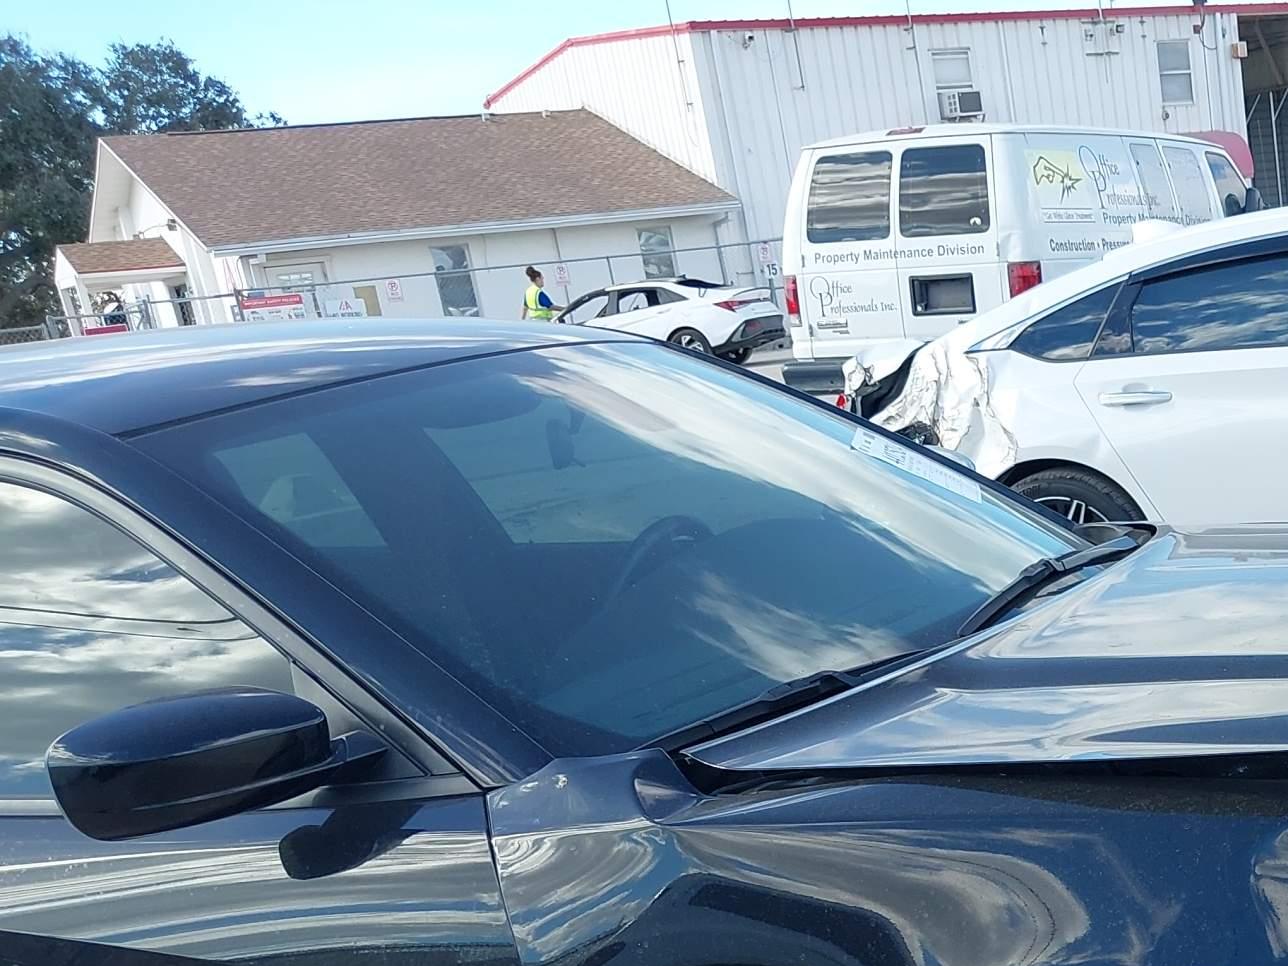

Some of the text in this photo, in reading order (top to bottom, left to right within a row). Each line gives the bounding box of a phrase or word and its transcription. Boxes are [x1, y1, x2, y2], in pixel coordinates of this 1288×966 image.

[1078, 145, 1120, 180] Office
[1102, 212, 1137, 227] Property
[814, 243, 985, 265] Property Maintenance Division
[1049, 238, 1096, 252] Construction
[766, 263, 778, 276] 15
[809, 275, 853, 300] Office
[818, 293, 898, 317] Professionals Inc.
